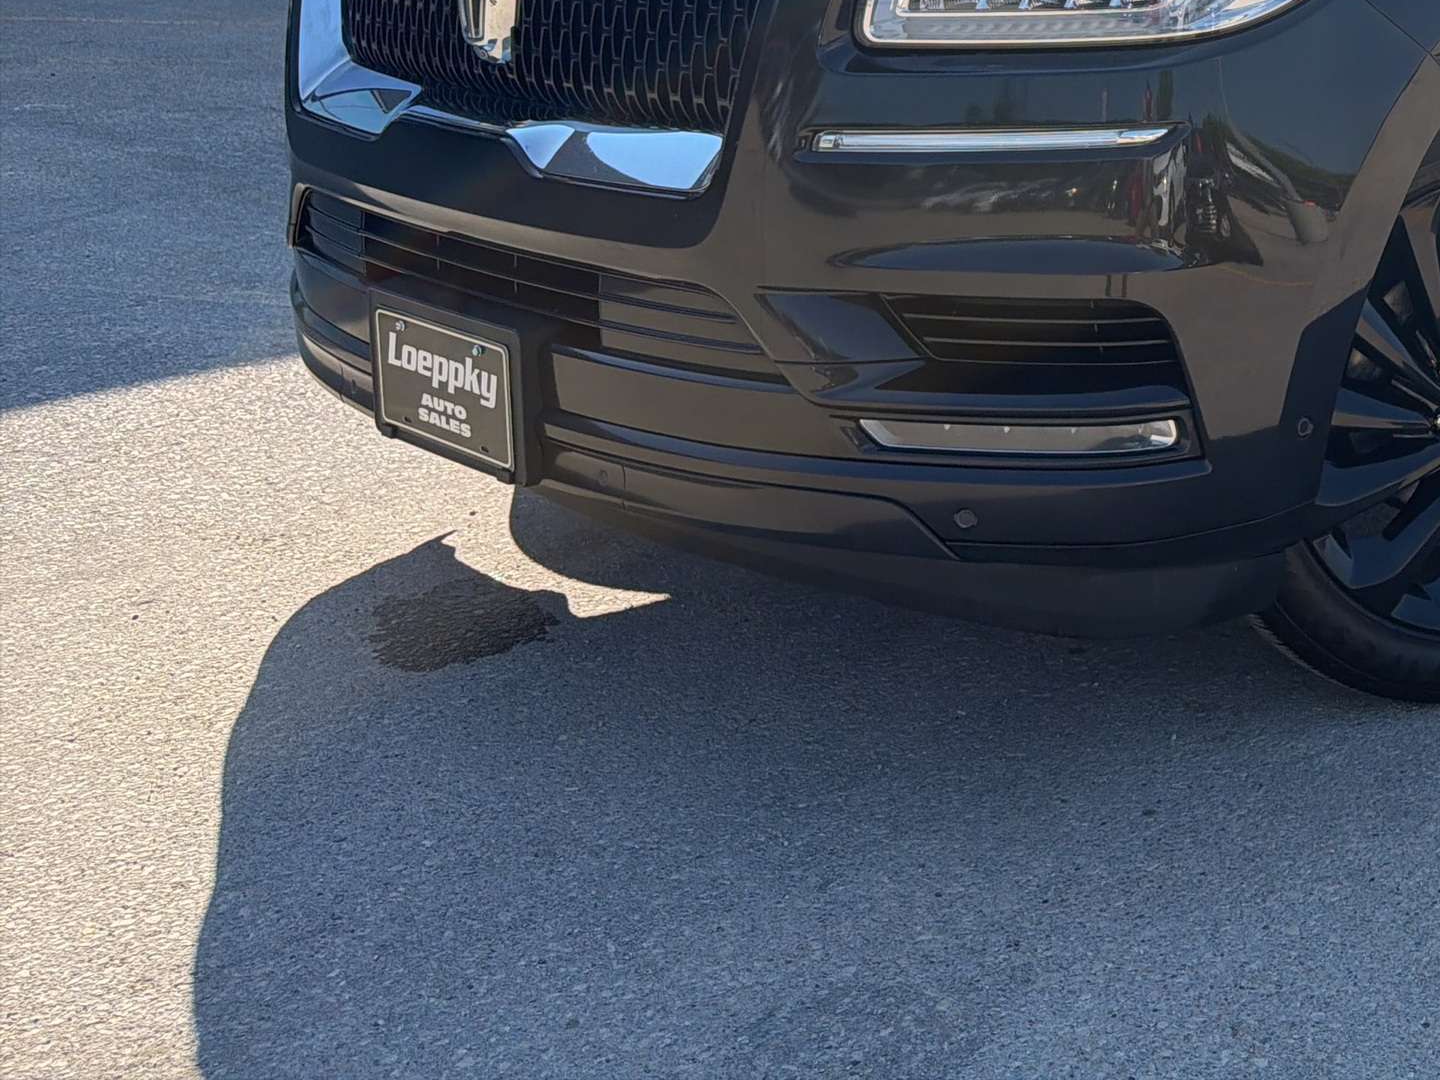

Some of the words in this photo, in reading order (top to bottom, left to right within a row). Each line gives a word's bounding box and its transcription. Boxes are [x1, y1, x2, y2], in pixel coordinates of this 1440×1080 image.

[387, 331, 498, 409] Loeppky
[420, 392, 468, 420] AUTO
[418, 407, 472, 438] SALES
